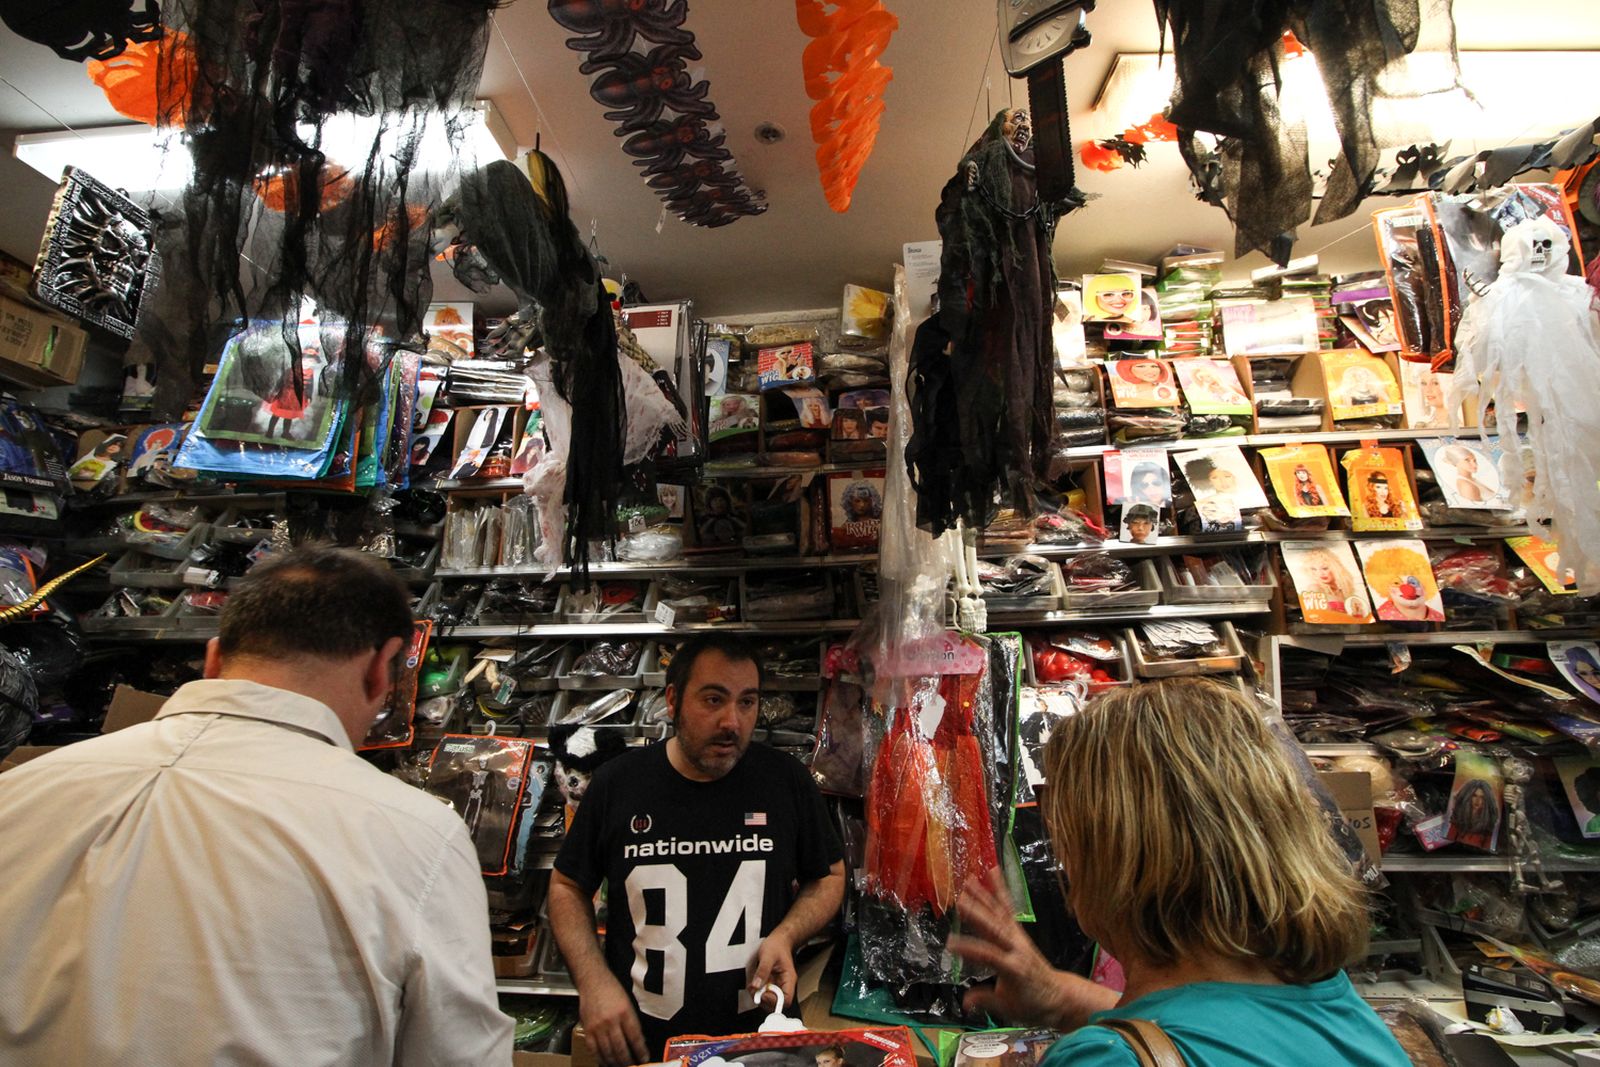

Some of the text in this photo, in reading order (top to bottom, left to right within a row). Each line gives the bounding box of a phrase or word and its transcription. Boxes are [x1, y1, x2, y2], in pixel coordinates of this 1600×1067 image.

[3, 473, 23, 482] JASON
[1303, 598, 1328, 610] WIG
[624, 834, 774, 859] nationwide
[624, 859, 767, 1021] 84
